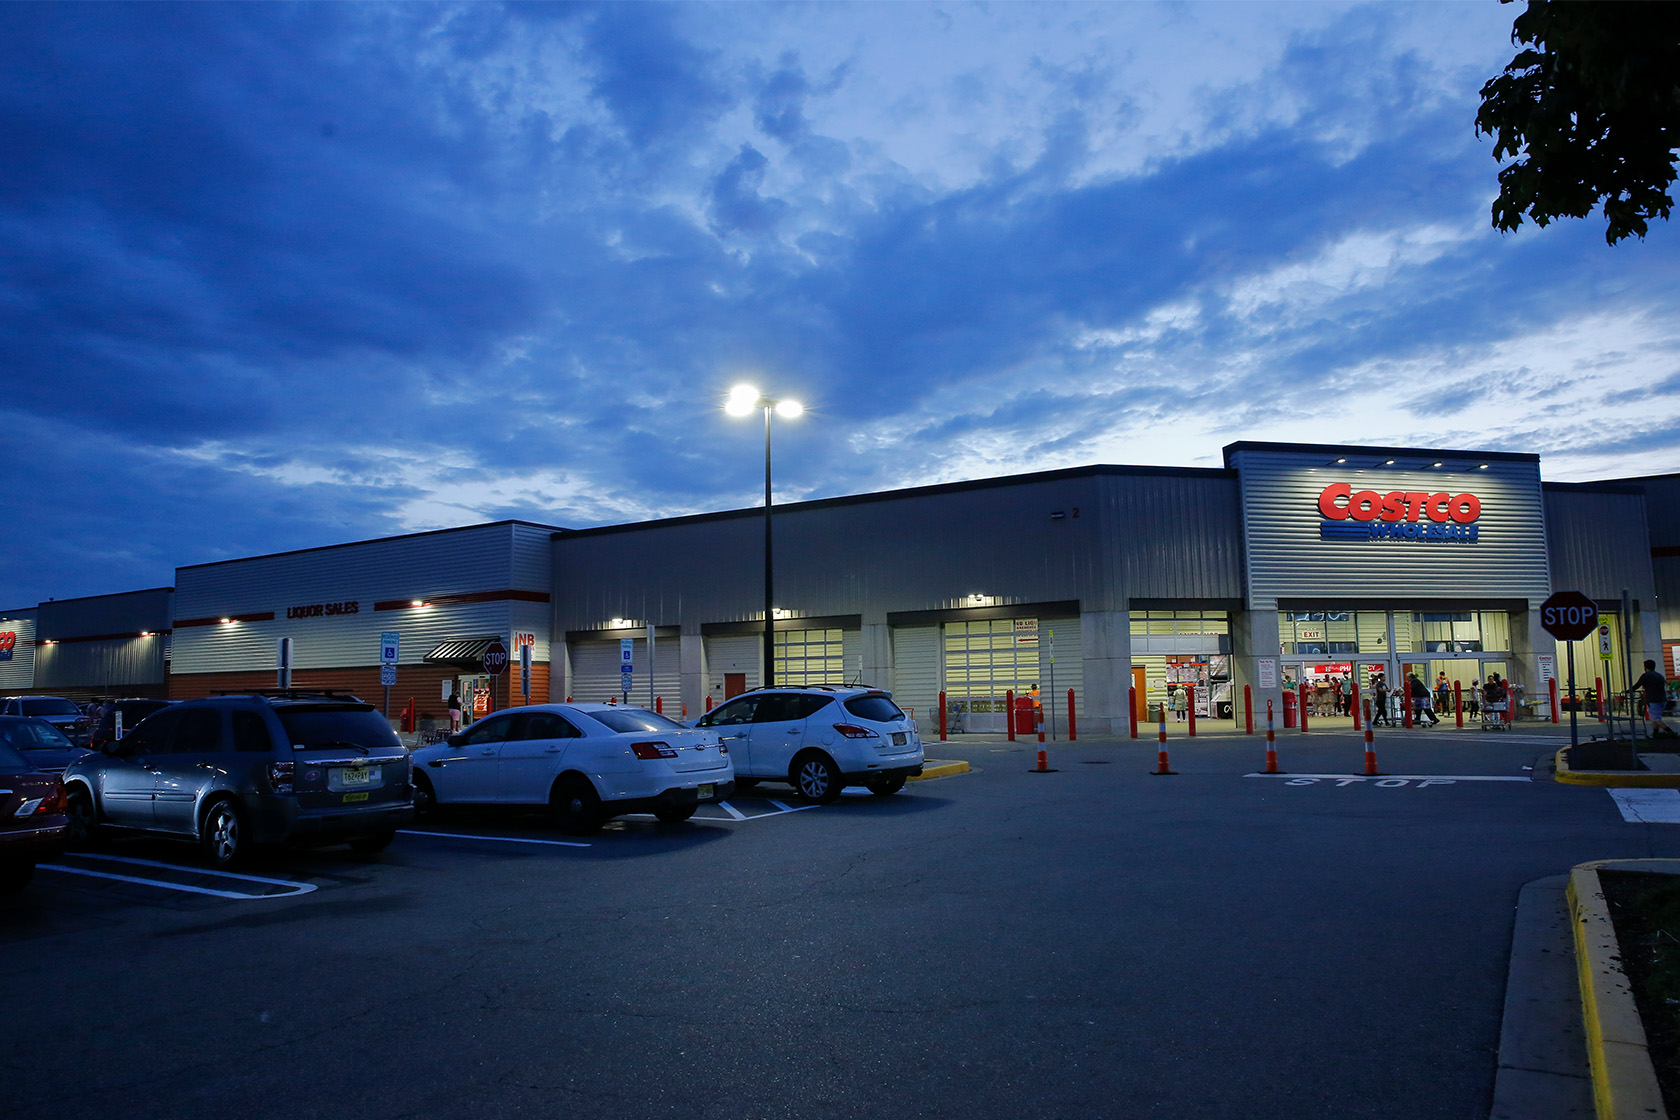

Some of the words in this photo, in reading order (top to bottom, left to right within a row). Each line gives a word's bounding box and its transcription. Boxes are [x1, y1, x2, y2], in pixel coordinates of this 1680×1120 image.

[1318, 482, 1482, 523] COSTCO
[1072, 507, 1080, 518] 2
[1369, 523, 1479, 541] WHOLESALE
[287, 604, 323, 619] LIQUOR
[325, 601, 359, 616] SALES
[1545, 606, 1594, 625] STOP
[485, 652, 506, 665] STOP
[1284, 777, 1457, 788] STOP
